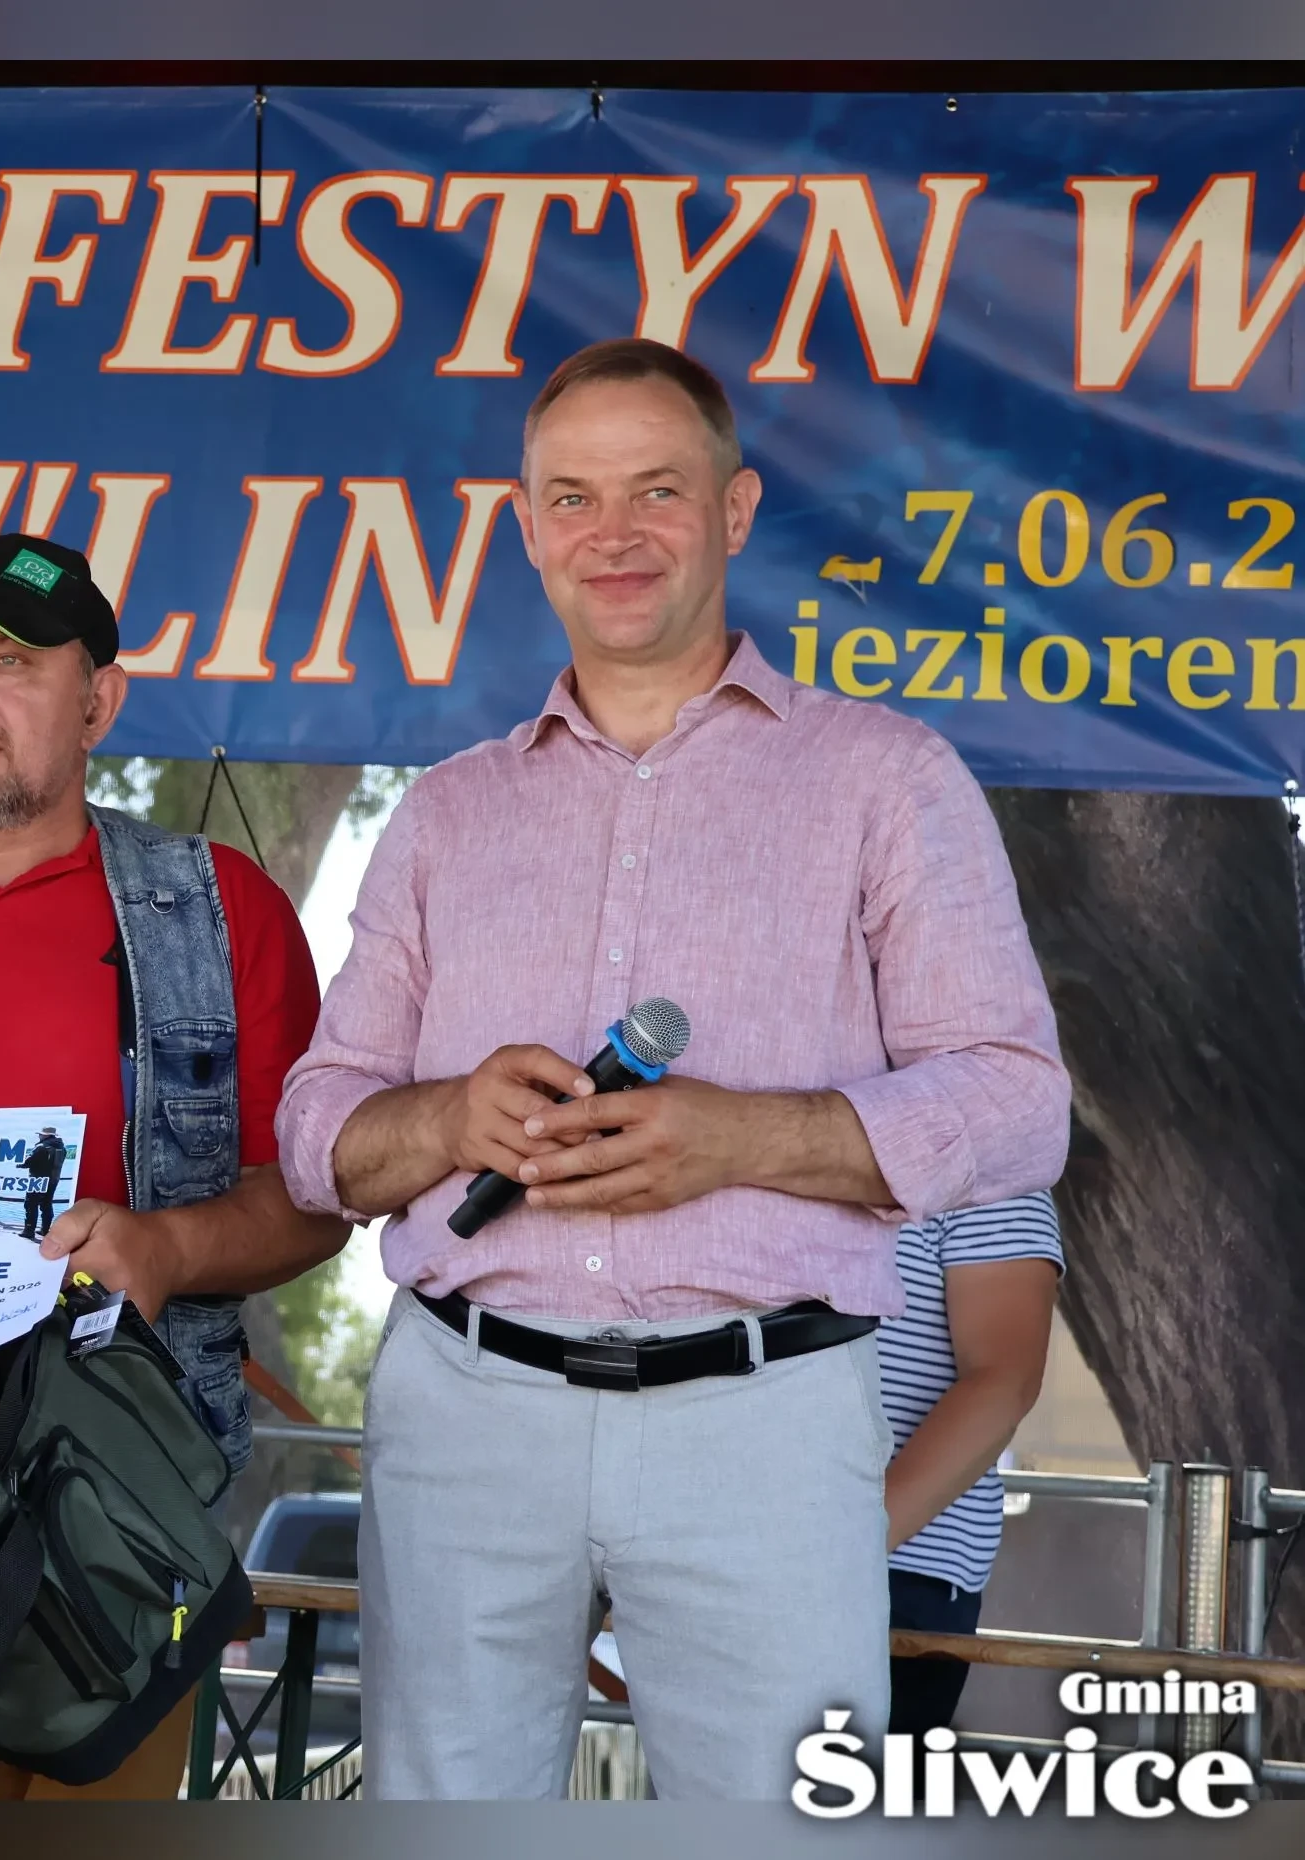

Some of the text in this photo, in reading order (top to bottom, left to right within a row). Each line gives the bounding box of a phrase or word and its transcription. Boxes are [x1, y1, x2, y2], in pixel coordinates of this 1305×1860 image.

[818, 489, 1295, 590] 7.06.2
[10, 564, 49, 588] Bank
[8, 1281, 42, 1293] 2026
